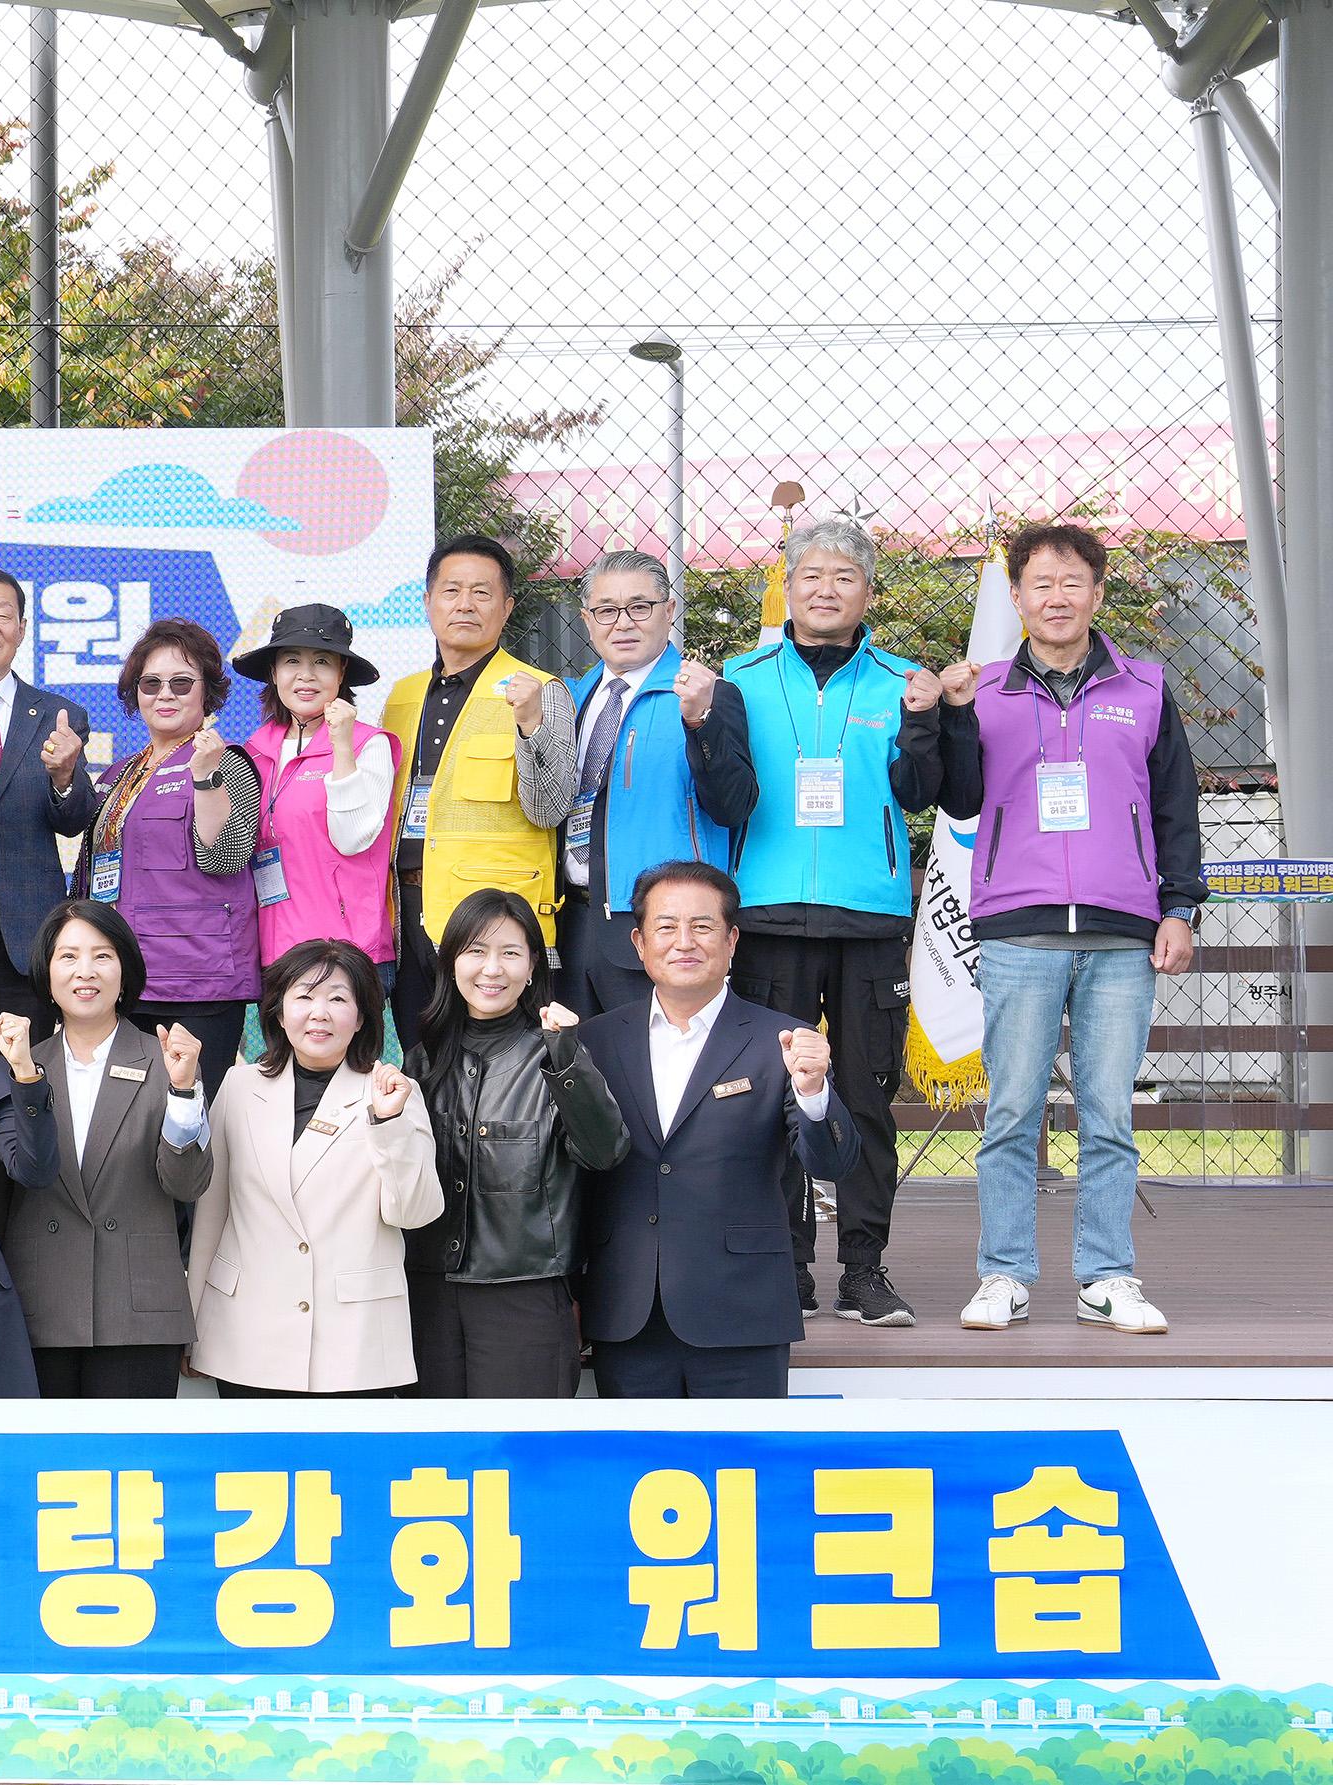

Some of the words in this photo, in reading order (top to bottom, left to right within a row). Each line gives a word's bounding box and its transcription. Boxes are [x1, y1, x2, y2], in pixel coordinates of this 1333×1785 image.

[1106, 705, 1134, 718] 초월읍
[1203, 863, 1242, 877] 2026년
[1243, 863, 1276, 877] 광주시
[1206, 875, 1281, 894] 역량강화
[1282, 875, 1333, 894] 워크숍
[1248, 984, 1293, 1001] 광주시
[628, 1464, 1124, 1653] 워크숍
